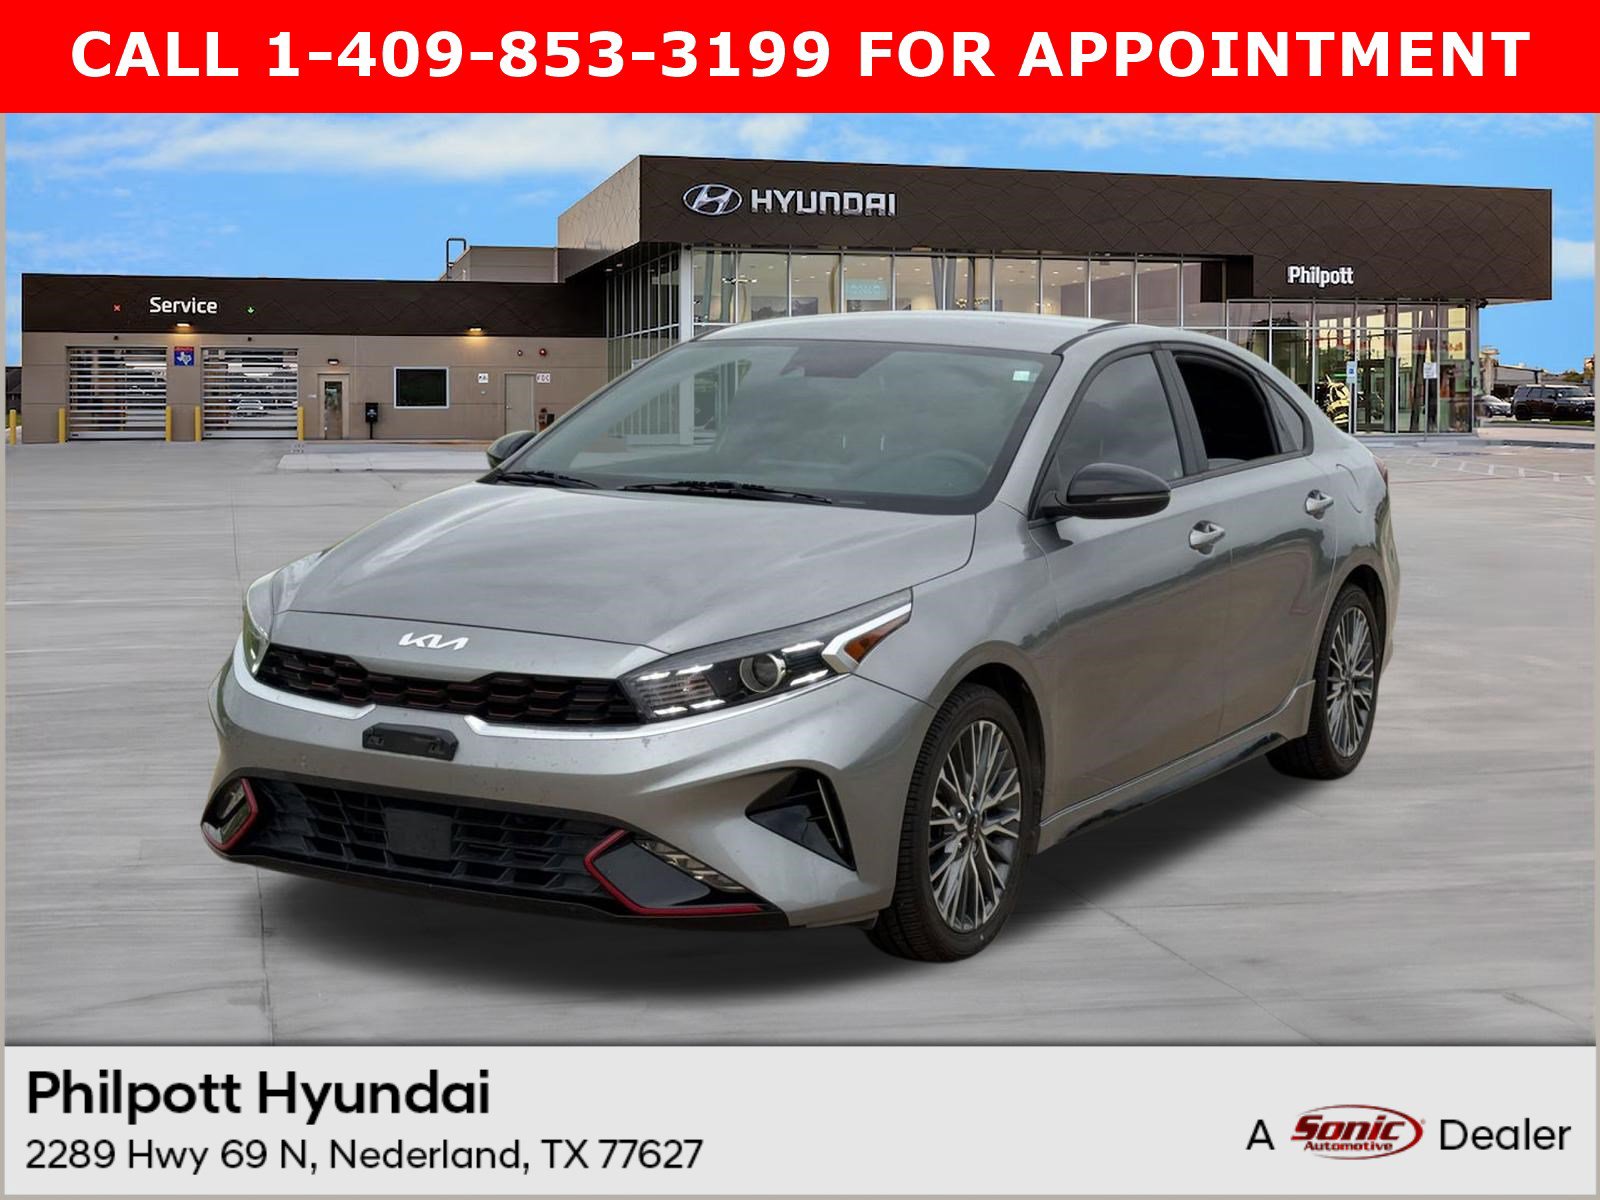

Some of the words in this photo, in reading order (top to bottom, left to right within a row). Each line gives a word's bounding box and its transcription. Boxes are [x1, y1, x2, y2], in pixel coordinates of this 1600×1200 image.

[751, 189, 896, 216] HYUNDAI
[1287, 265, 1354, 288] Philpott
[149, 296, 218, 314] Service
